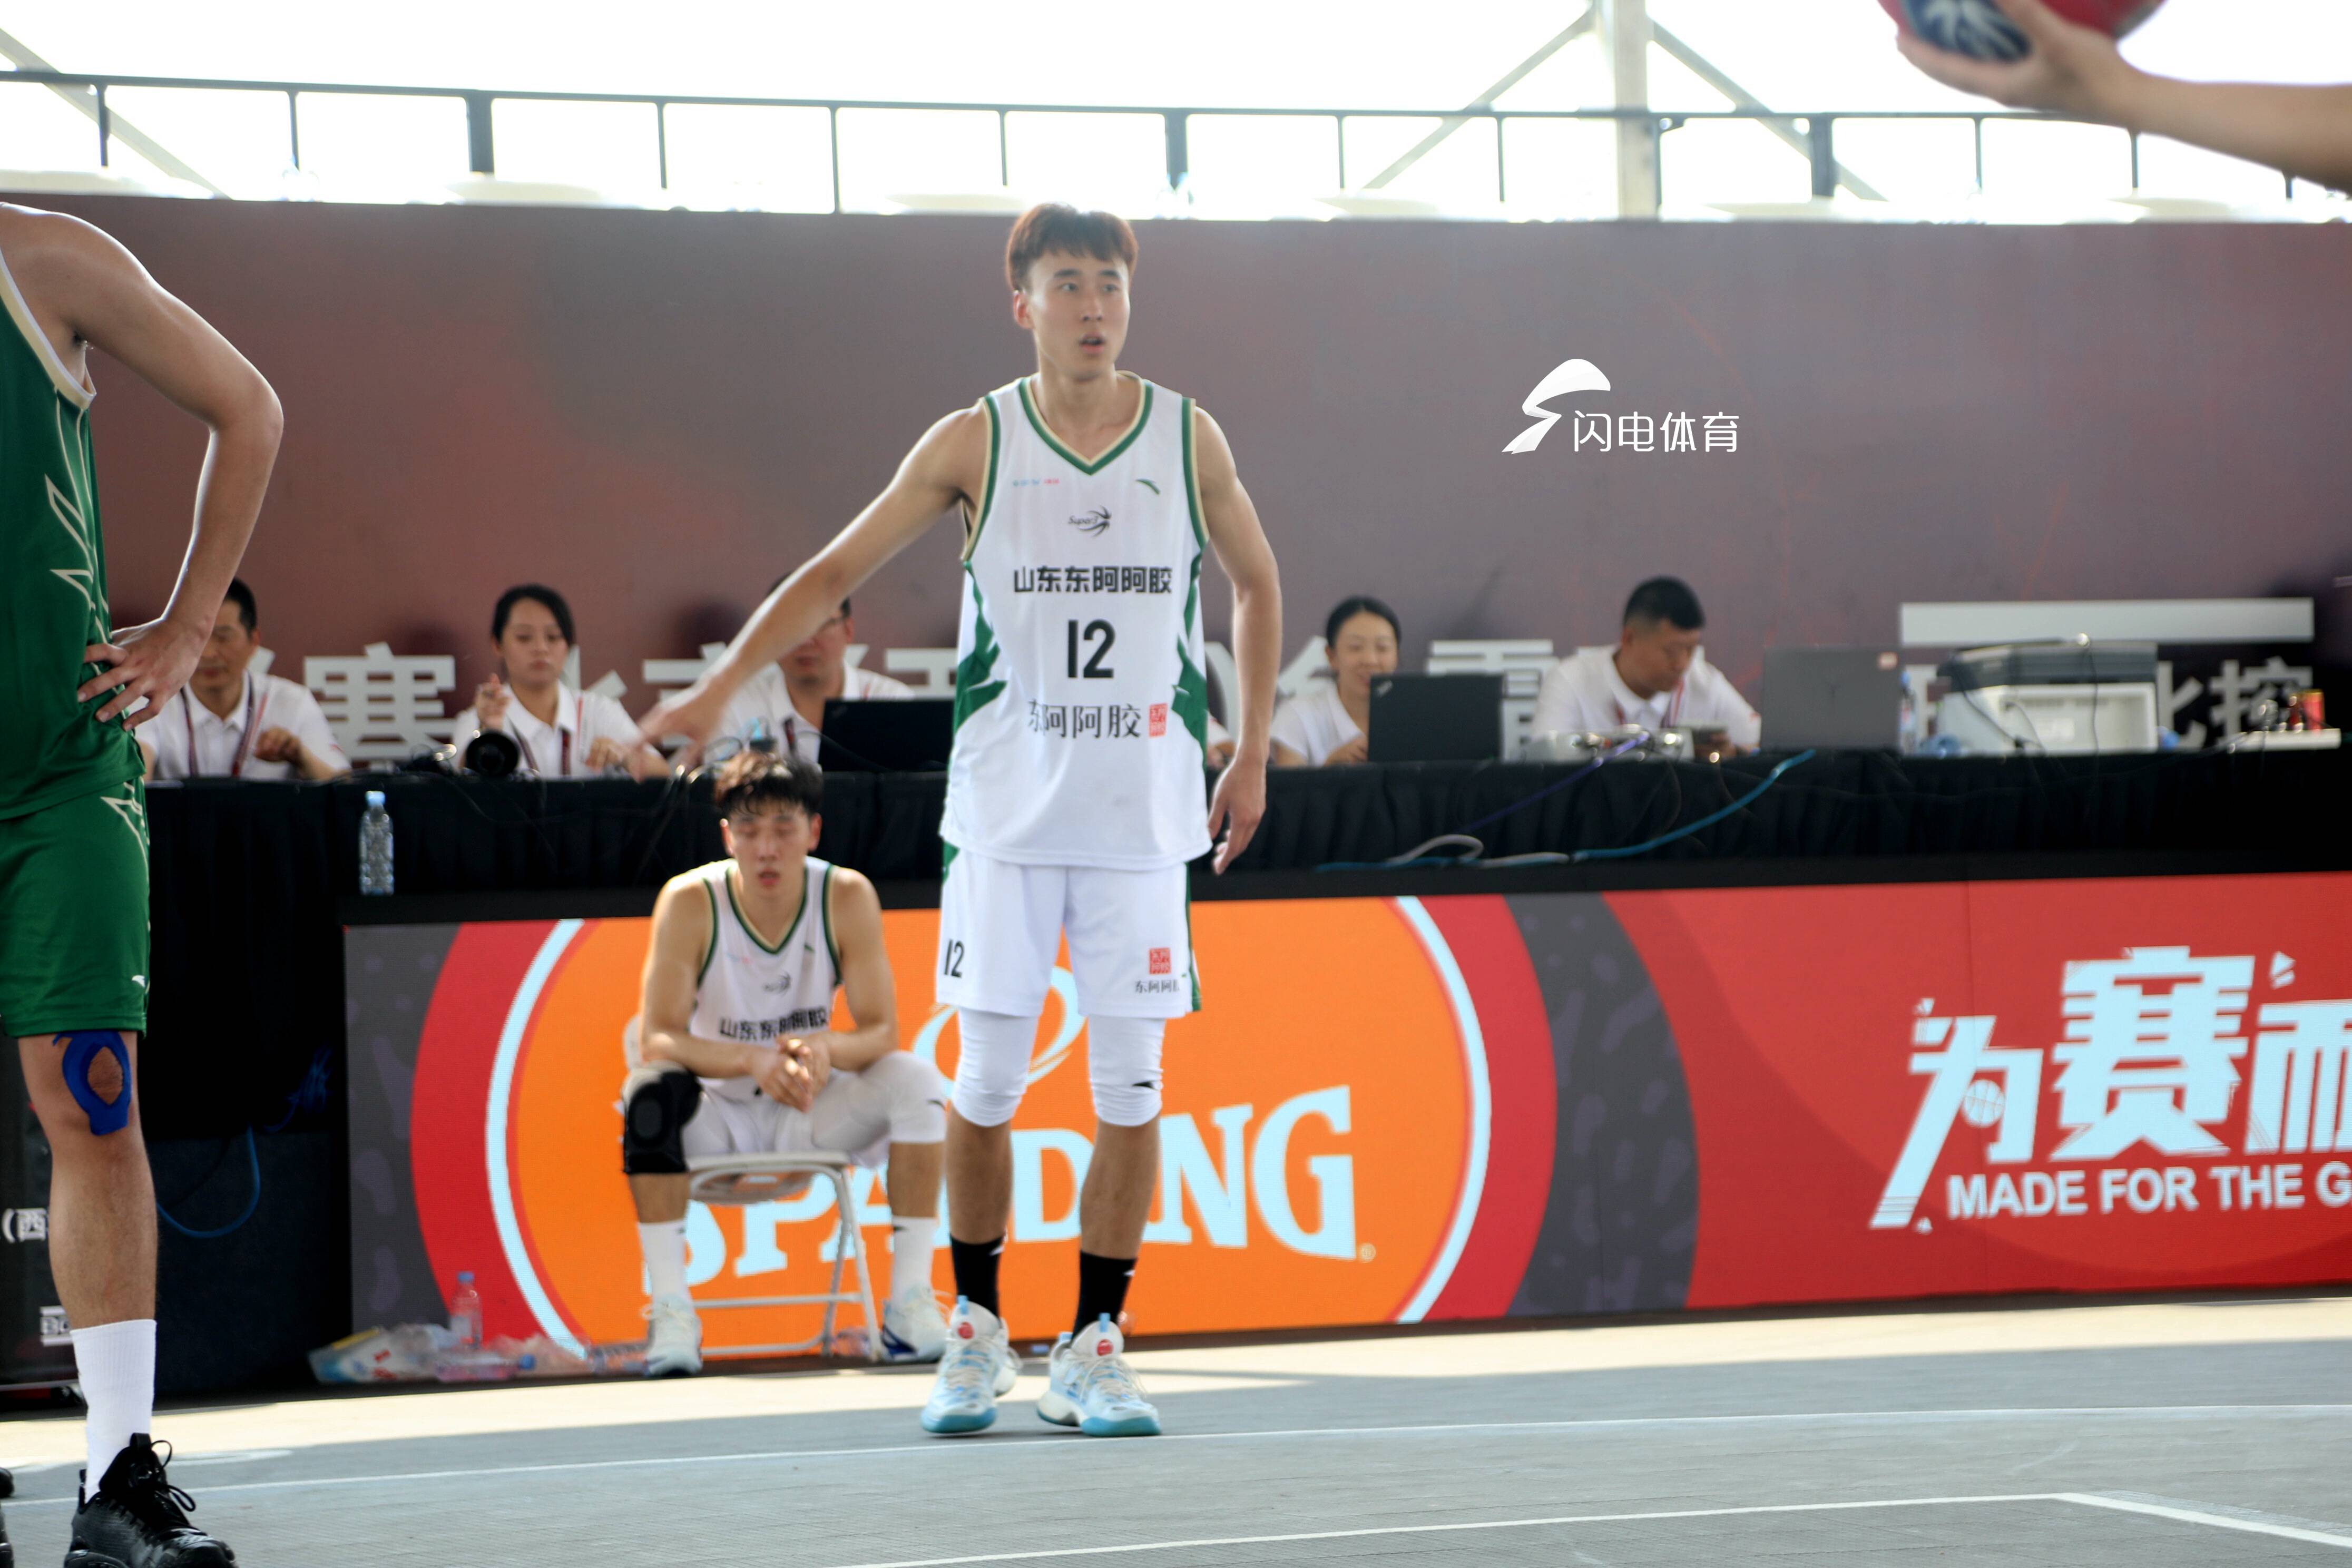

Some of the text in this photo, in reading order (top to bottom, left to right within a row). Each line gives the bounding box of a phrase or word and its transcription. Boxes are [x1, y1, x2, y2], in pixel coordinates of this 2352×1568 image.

[1014, 565, 1172, 595] 山东东阿阿胶
[1067, 619, 1116, 679] 12
[943, 938, 965, 978] 12
[1947, 1168, 2088, 1220] MADE
[2100, 1166, 2199, 1214] FOR
[2208, 1163, 2306, 1210] THE
